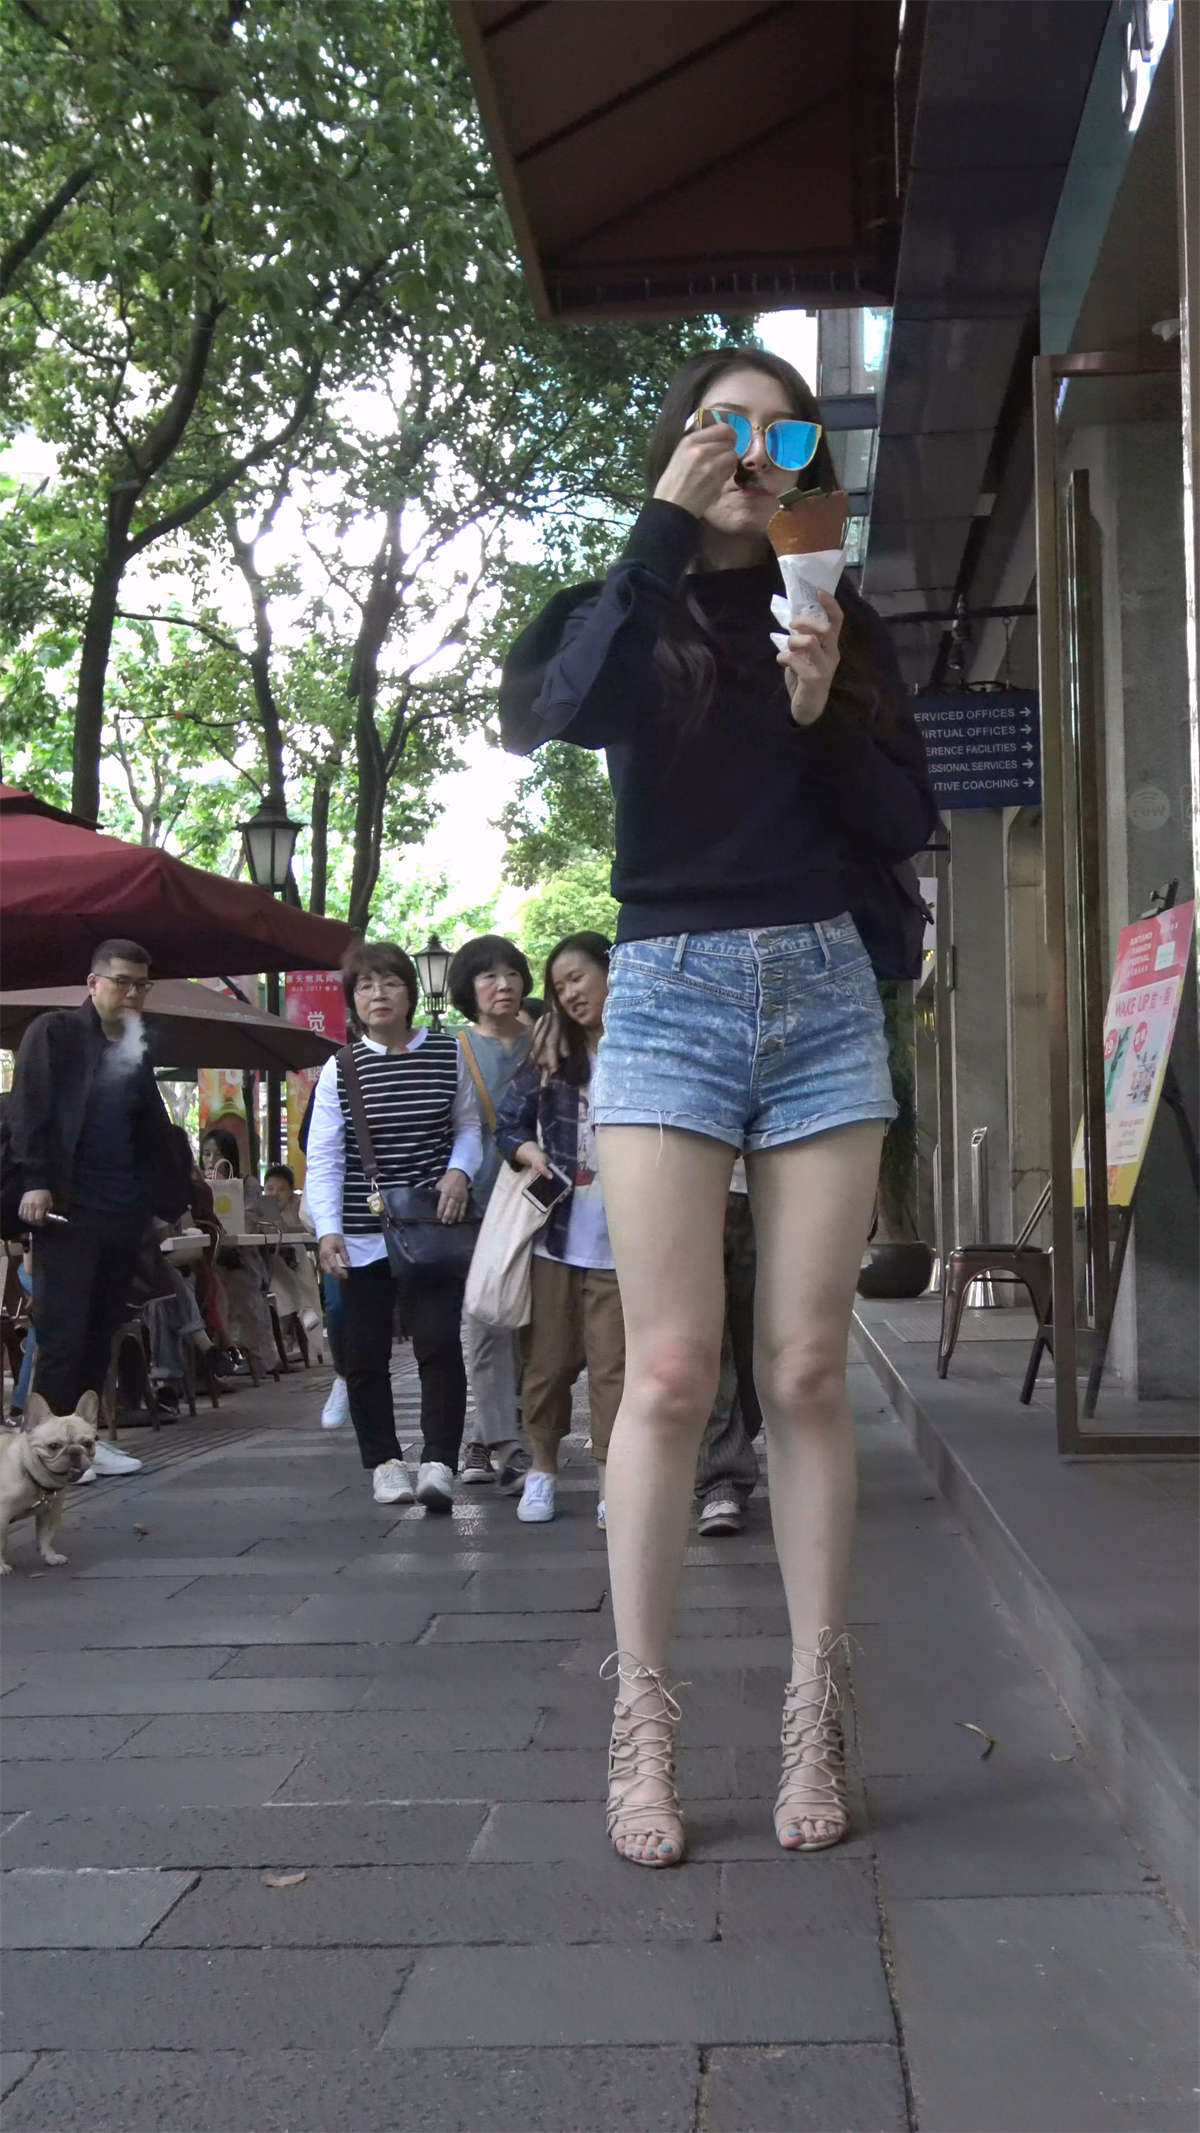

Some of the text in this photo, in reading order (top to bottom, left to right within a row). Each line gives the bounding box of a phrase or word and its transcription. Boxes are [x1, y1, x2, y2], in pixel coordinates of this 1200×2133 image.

[966, 708, 1015, 720] OFFICES
[967, 725, 1017, 737] OFFICES
[966, 743, 1017, 755] FACILITIES
[972, 760, 1018, 772] SERVICES
[962, 778, 1019, 791] COACHING
[1115, 997, 1137, 1017] WAKE
[1138, 993, 1151, 1012] UP
[307, 1011, 325, 1032] 觉
